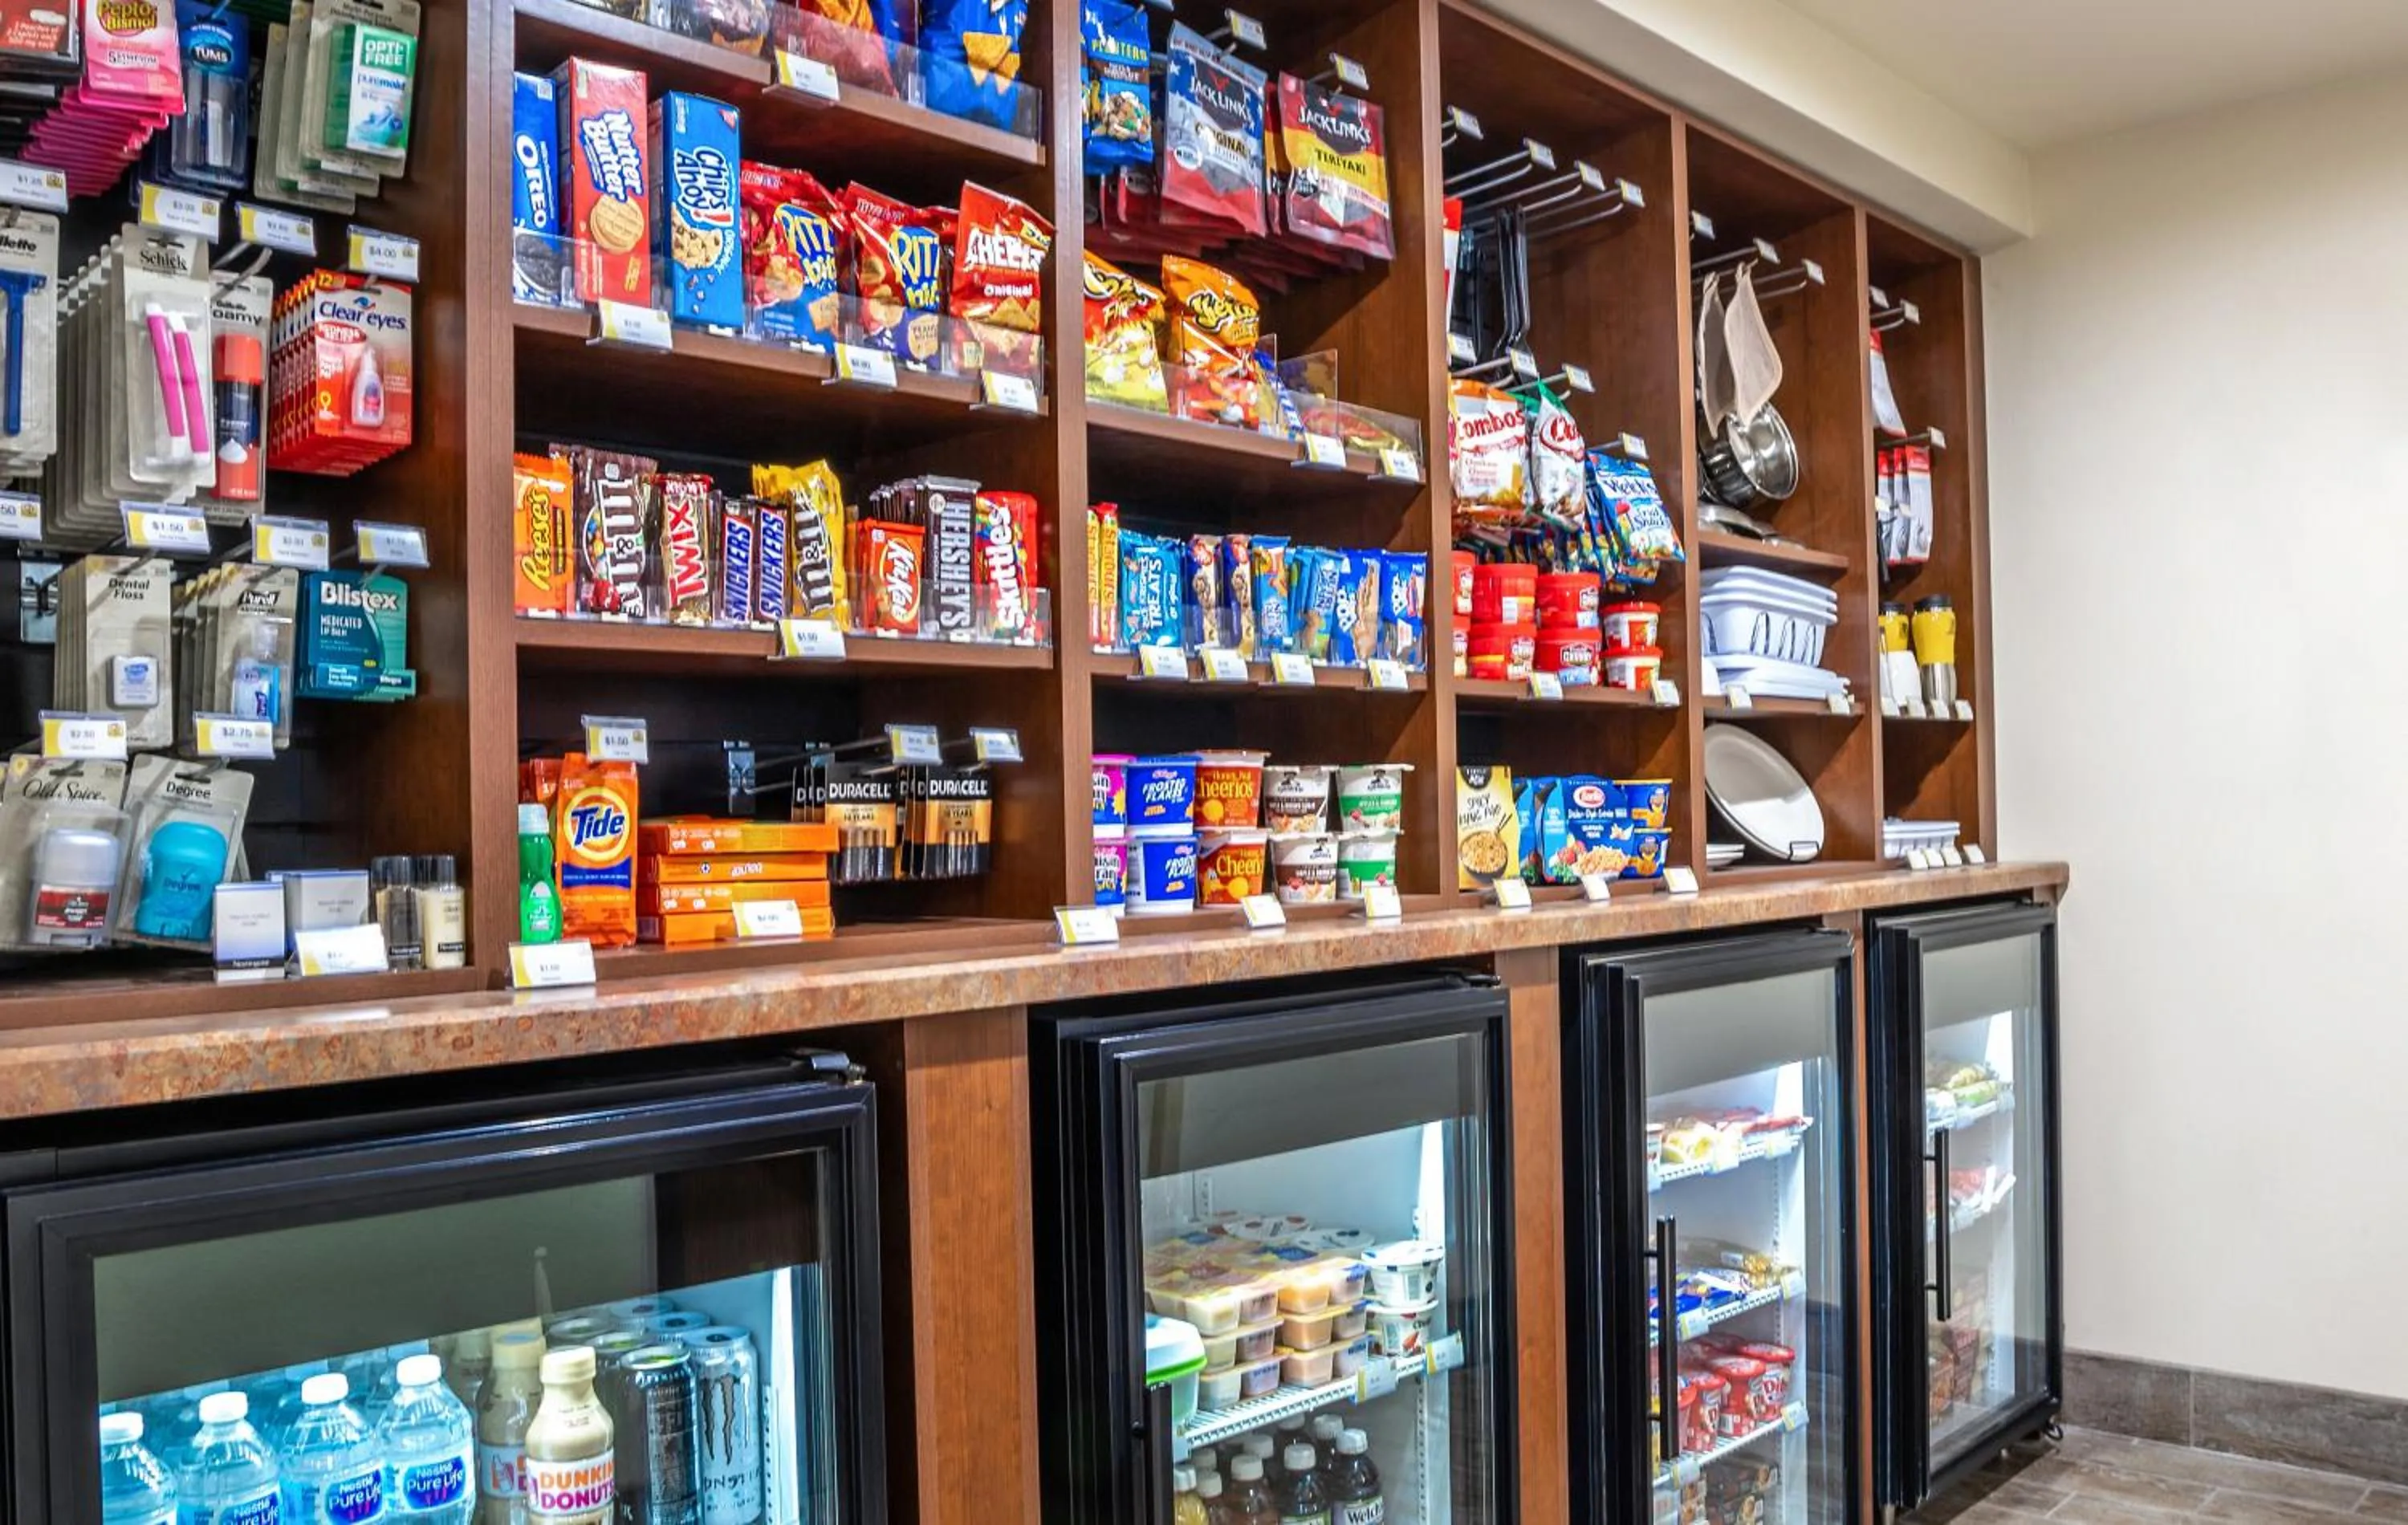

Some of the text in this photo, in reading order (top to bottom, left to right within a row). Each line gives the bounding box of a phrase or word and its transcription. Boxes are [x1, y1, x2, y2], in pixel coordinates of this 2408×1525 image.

[193, 46, 229, 63] TUMS
[365, 52, 404, 66] FREE
[1190, 76, 1222, 108] JACK
[1298, 106, 1329, 133] JACK
[515, 134, 547, 229] OREO
[0, 235, 37, 252] llette
[140, 249, 188, 271] Schick
[888, 230, 940, 285] RIT
[209, 310, 263, 325] oamy
[319, 300, 406, 331] Clear eyes
[1458, 409, 1525, 440] ombos
[152, 521, 185, 533] $1.50
[667, 501, 707, 608] TWIX
[759, 509, 786, 619] SNICKERS
[725, 518, 752, 622] SNICKERS
[985, 506, 1025, 629] Skittles
[108, 577, 151, 591] Dental
[113, 588, 144, 600] Floss
[1147, 558, 1163, 629] TREATS
[321, 580, 398, 614] Blistex
[321, 615, 363, 628] MEDICATED
[22, 778, 103, 801] Old Spice
[165, 780, 211, 800] Degree
[829, 782, 890, 799] DURACELL
[929, 779, 987, 795] DURACELL
[1199, 779, 1254, 799] heerios
[570, 805, 626, 849] Tide
[1216, 855, 1263, 876] Cheeri
[406, 1467, 463, 1491] Pure Life
[328, 1490, 364, 1511] Pure
[540, 1482, 615, 1511] DONUTS
